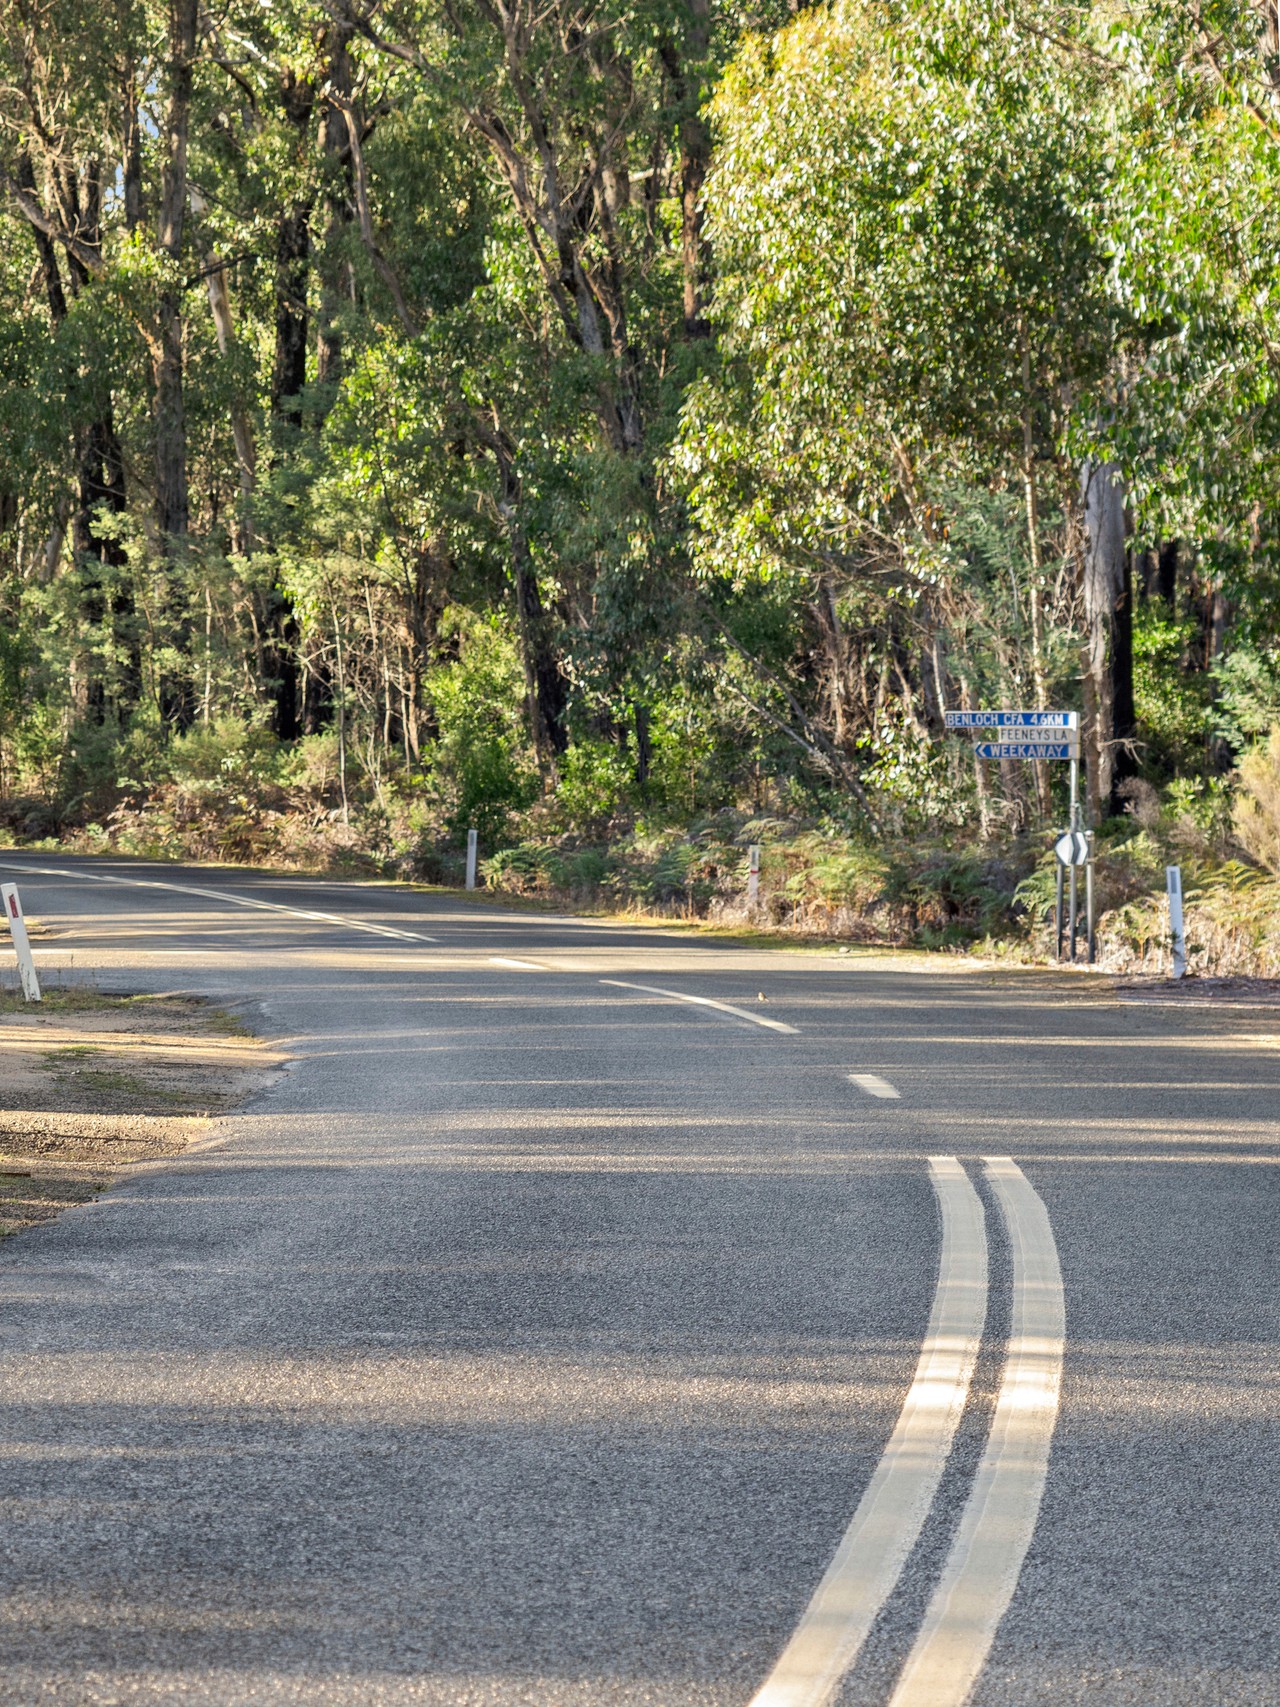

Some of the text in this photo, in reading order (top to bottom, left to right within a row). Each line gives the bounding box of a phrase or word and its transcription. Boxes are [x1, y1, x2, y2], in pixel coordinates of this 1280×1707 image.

[947, 714, 1063, 726] BENLOCH CFA 4.6KM
[1001, 729, 1067, 741] FEENEYS LA
[991, 745, 1063, 757] WEEKAWAY
